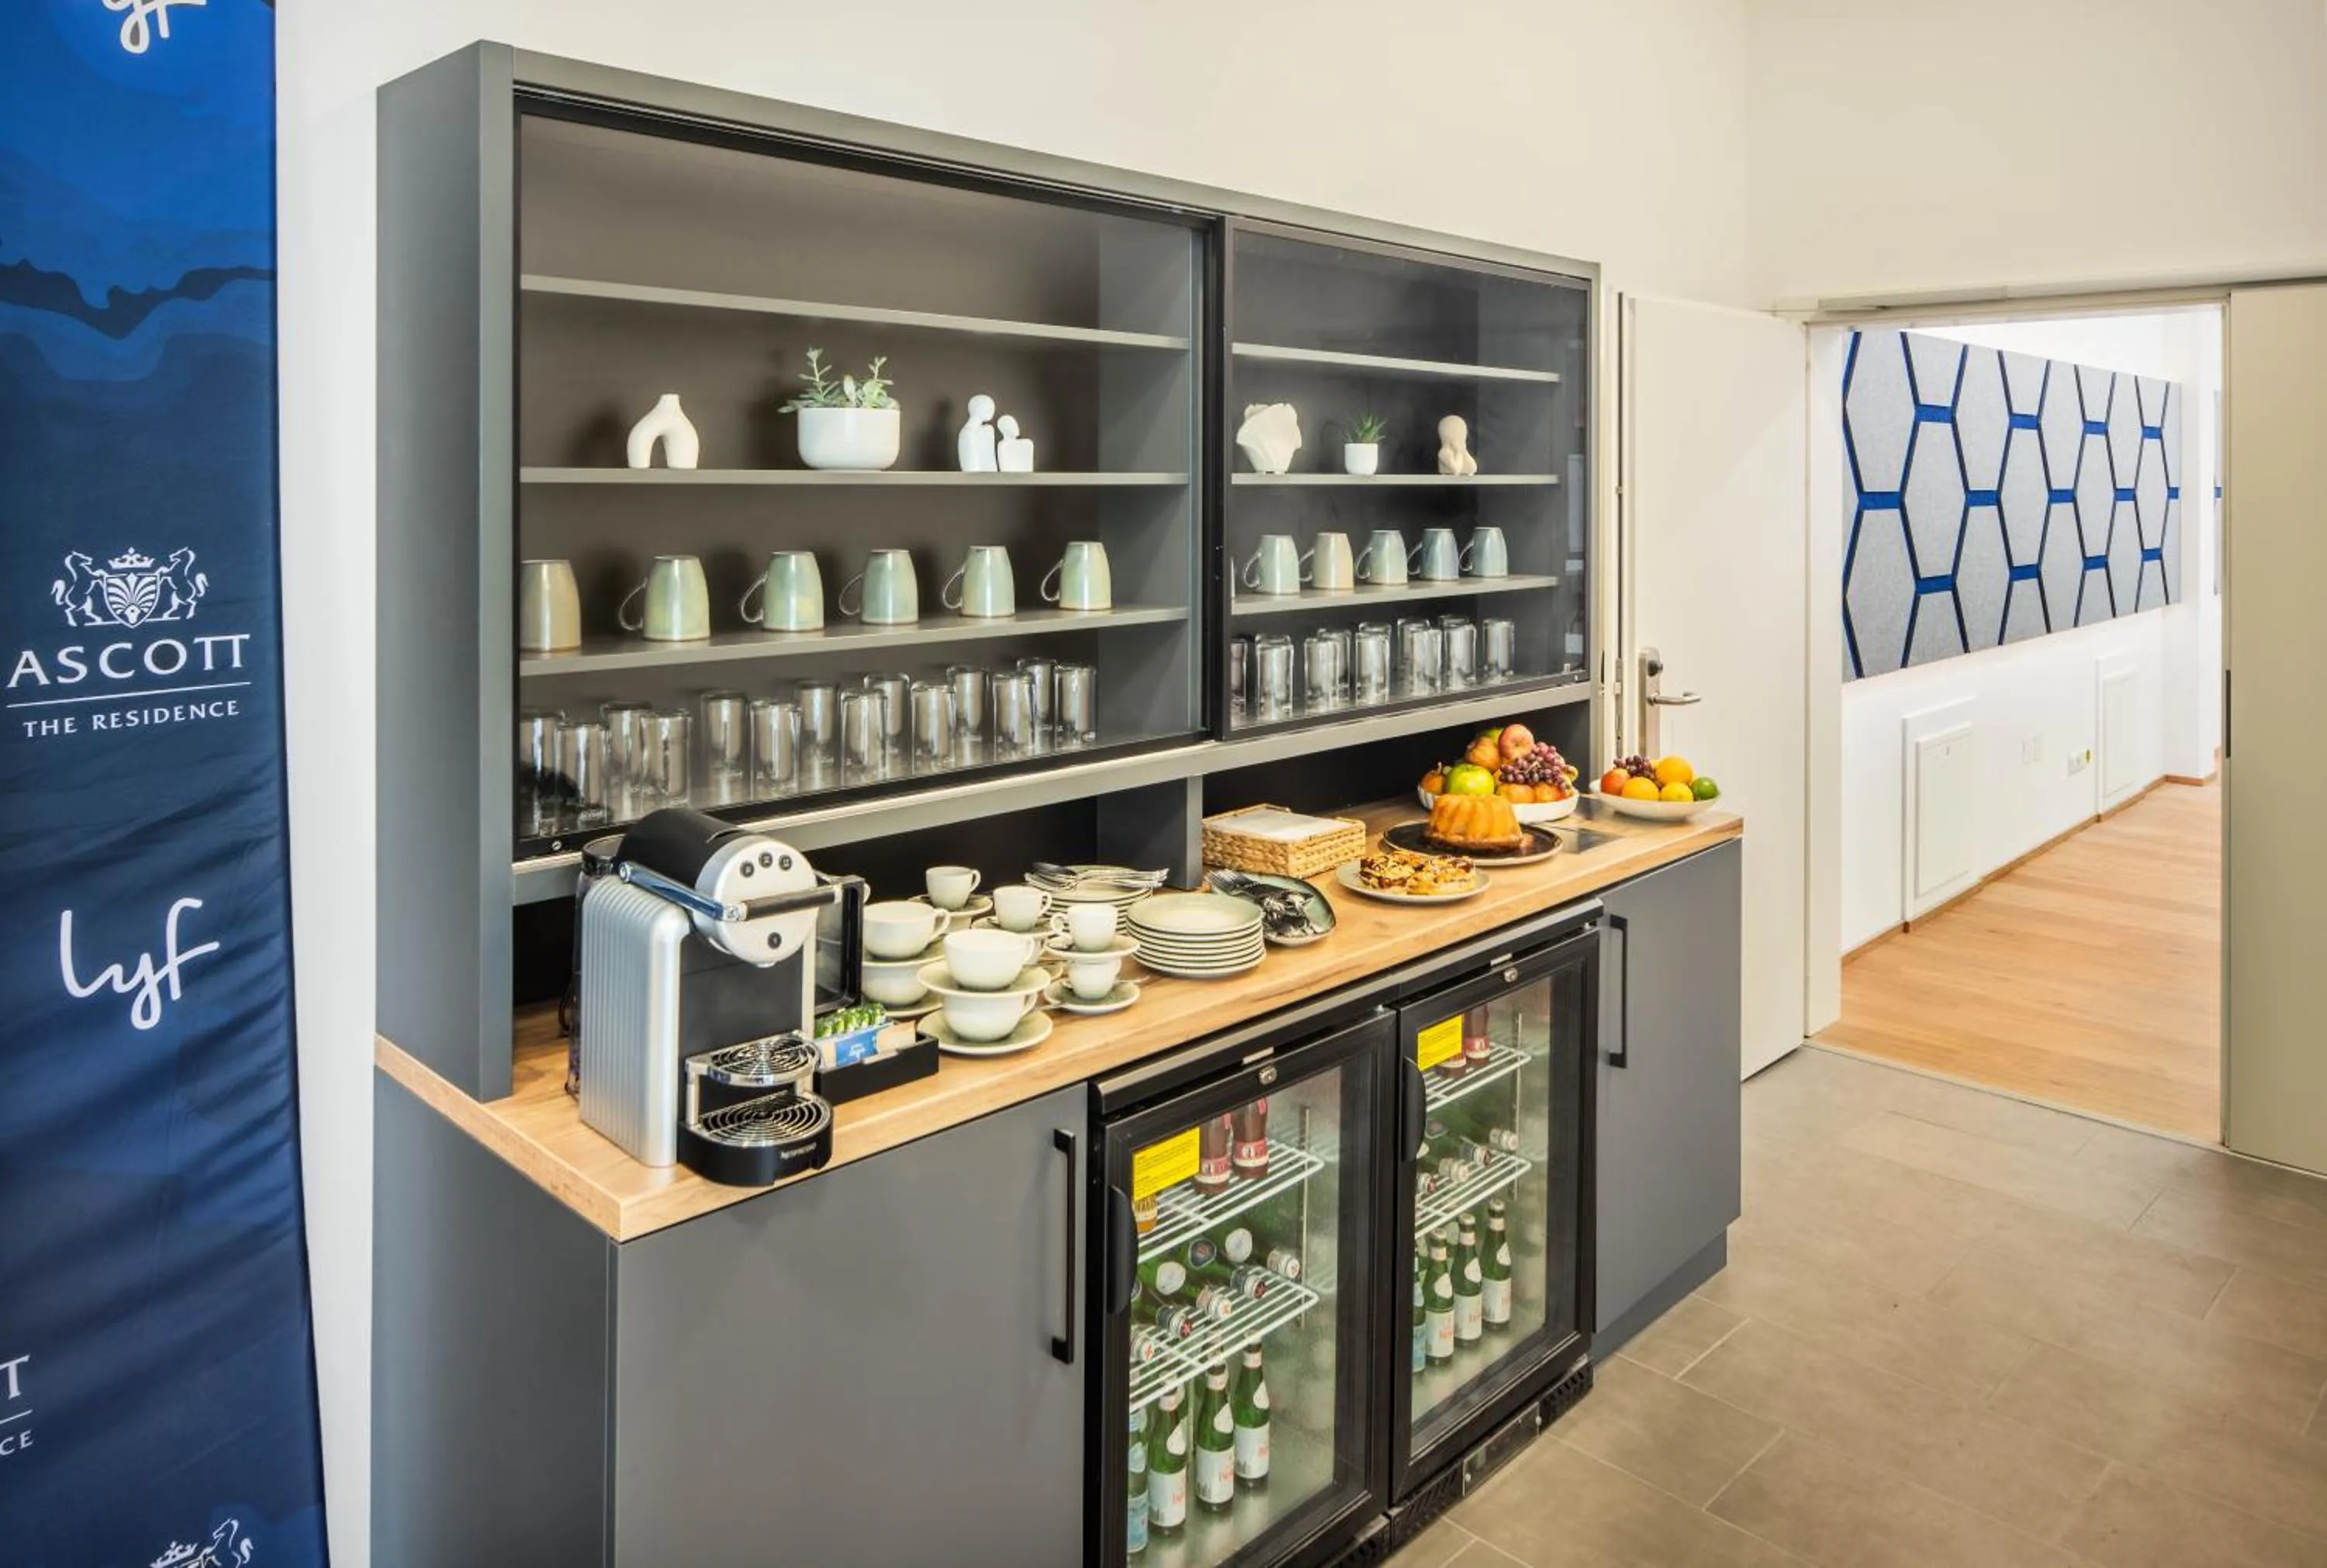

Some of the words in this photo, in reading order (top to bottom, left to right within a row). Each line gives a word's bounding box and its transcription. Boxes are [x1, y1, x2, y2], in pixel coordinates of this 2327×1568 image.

[7, 634, 251, 688] ASCOTT
[23, 717, 78, 738] THE
[92, 699, 240, 730] RESIDENCE
[60, 897, 220, 1030] lyf
